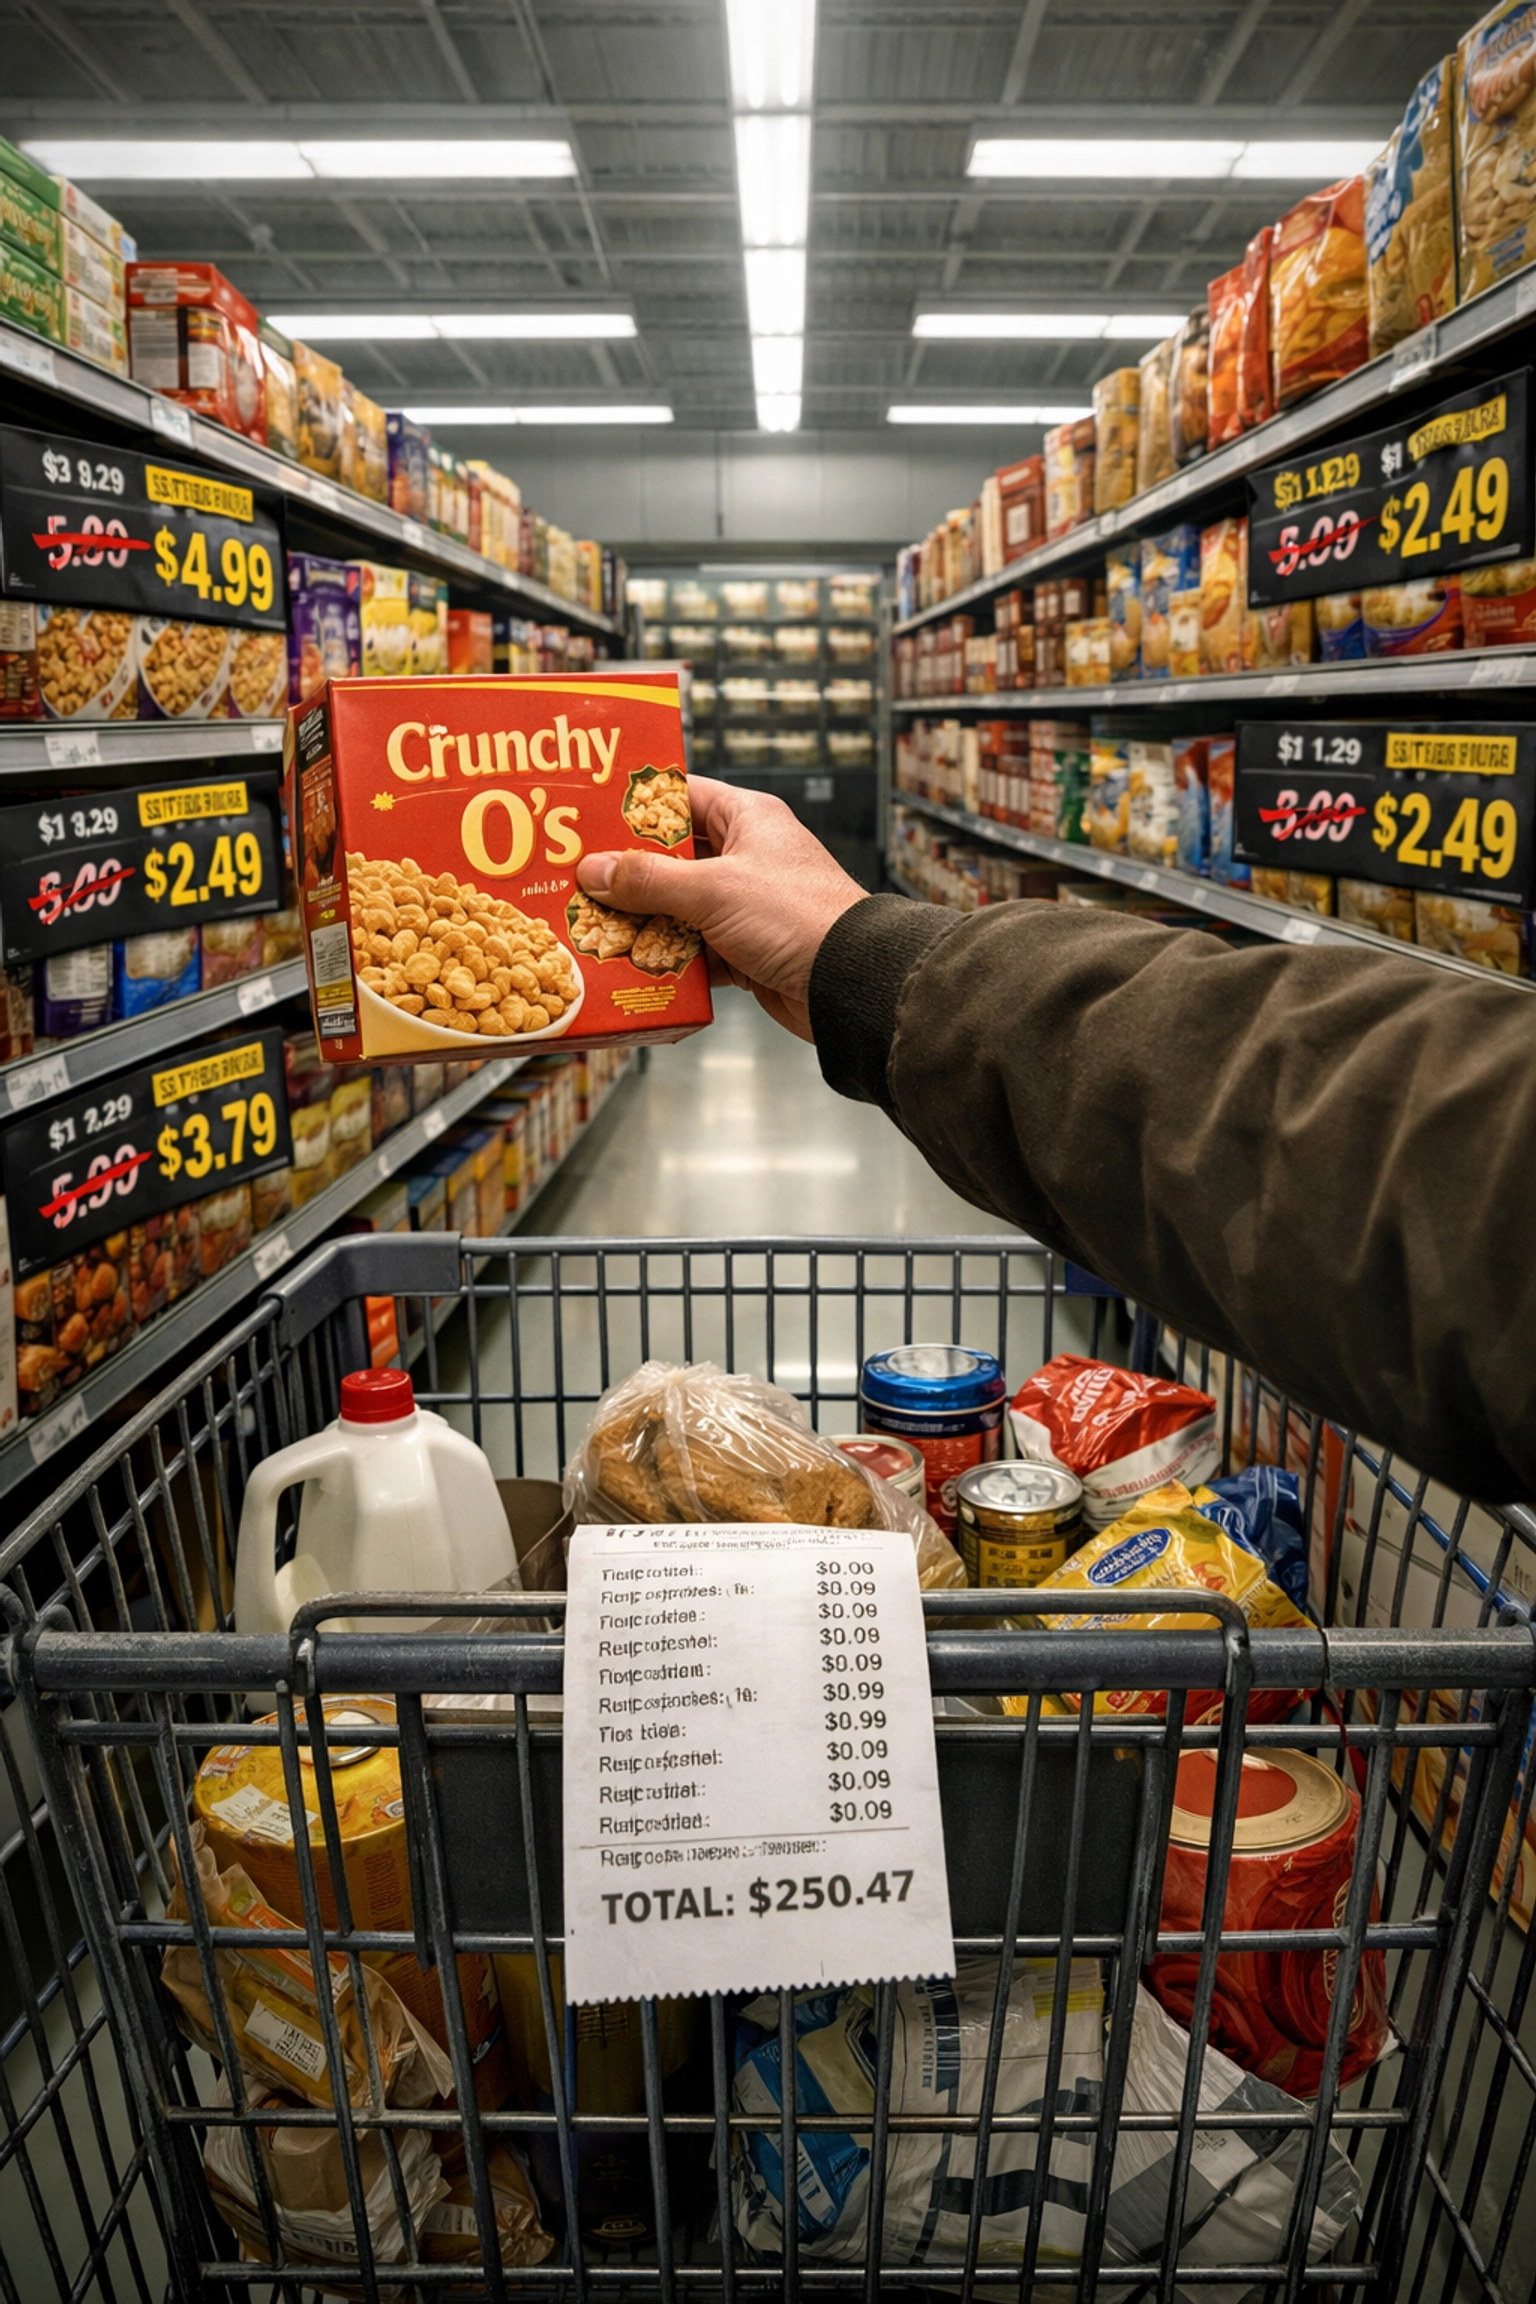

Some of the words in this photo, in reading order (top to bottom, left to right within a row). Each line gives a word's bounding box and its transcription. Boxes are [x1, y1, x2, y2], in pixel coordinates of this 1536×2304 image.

[1378, 456, 1510, 559] $2.49
[154, 525, 275, 612] $4.99
[387, 714, 621, 784] Crunchy
[1312, 737, 1363, 765] 1.29
[461, 787, 584, 877] O's
[1372, 791, 1518, 879] $2.49
[144, 831, 263, 906] $2.49
[157, 1092, 277, 1181] $3.79
[822, 1653, 882, 1673] $0.09
[823, 1681, 885, 1702] $0.99
[825, 1710, 887, 1732] $0.99
[826, 1739, 889, 1761] $0.09
[828, 1769, 891, 1792] $0.09
[829, 1800, 892, 1823] $0.09
[601, 1886, 734, 1924] TOTAL:
[749, 1870, 914, 1918] $250.47
